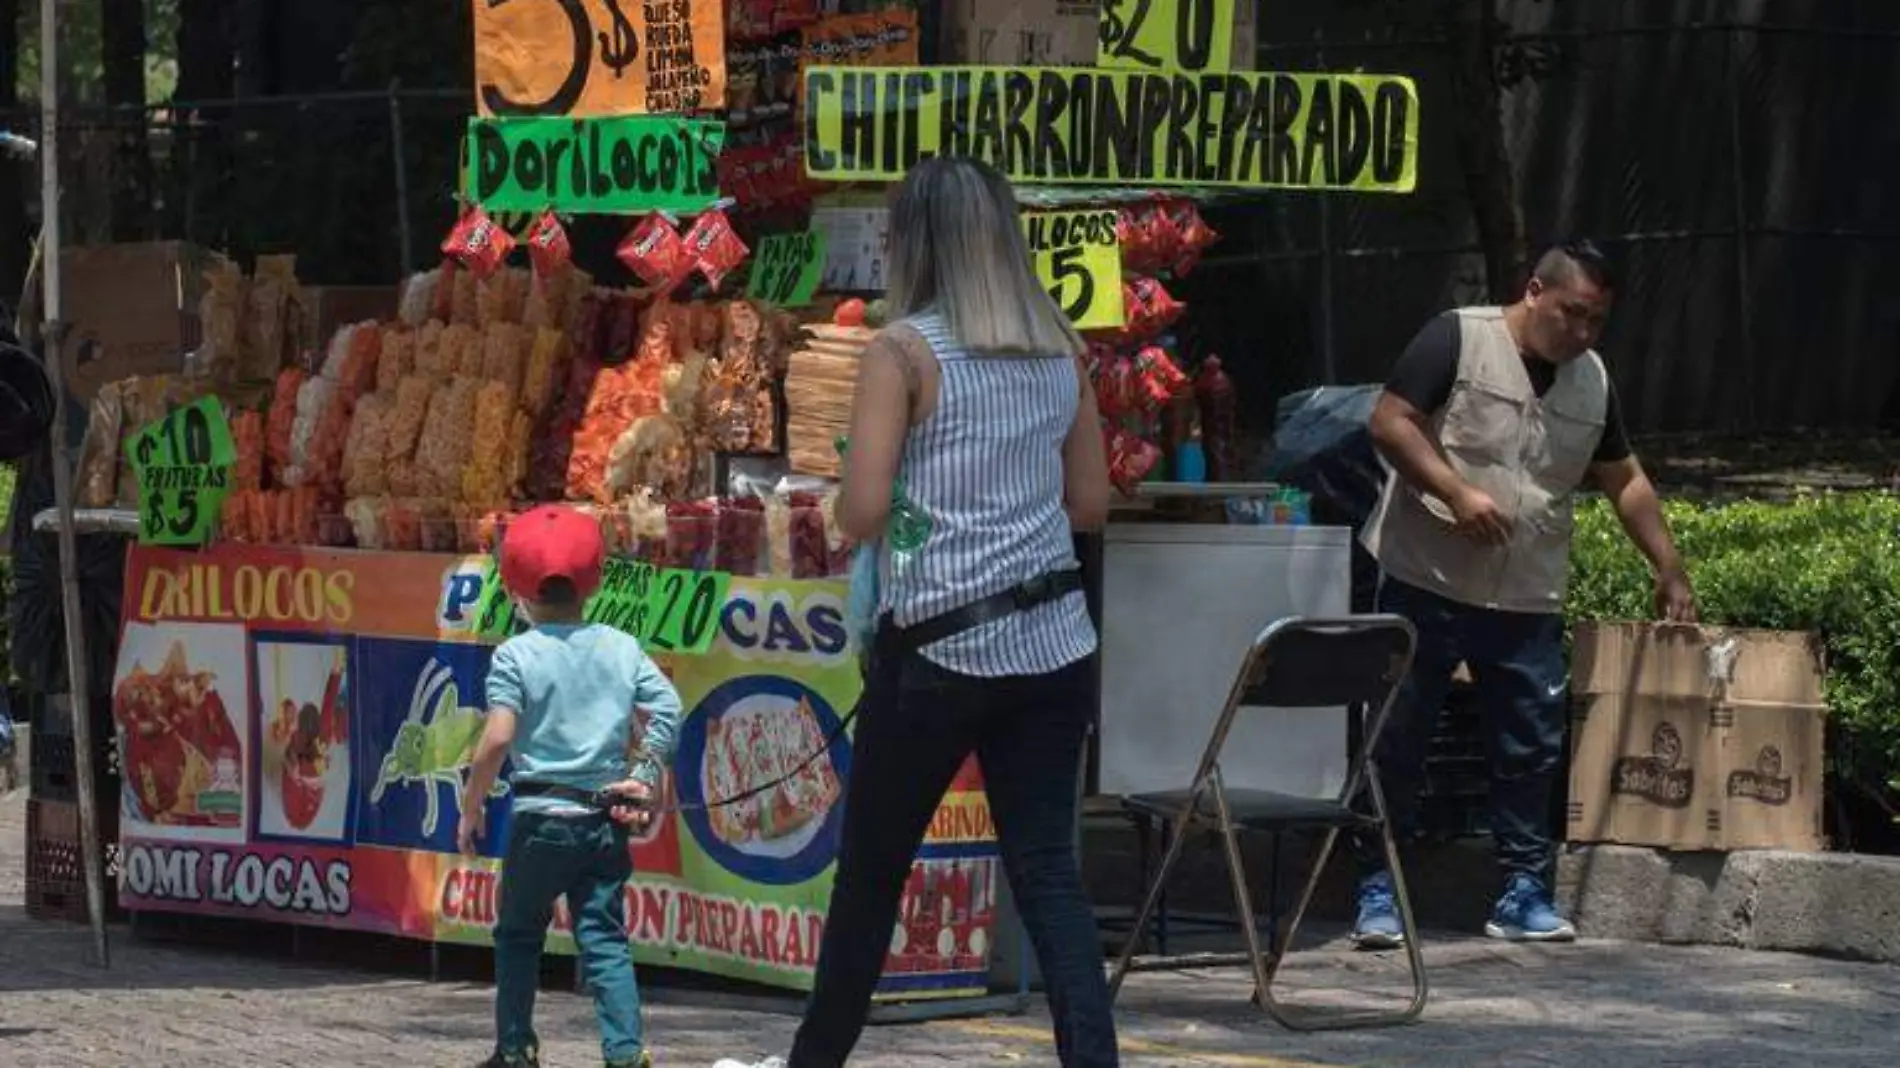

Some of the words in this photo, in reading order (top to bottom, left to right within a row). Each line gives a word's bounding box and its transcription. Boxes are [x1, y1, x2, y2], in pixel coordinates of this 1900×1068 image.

[1028, 212, 1116, 250] ILOCOS
[719, 597, 847, 655] CAS
[211, 852, 350, 914] LOCAS
[675, 890, 824, 968] PREPARAD
